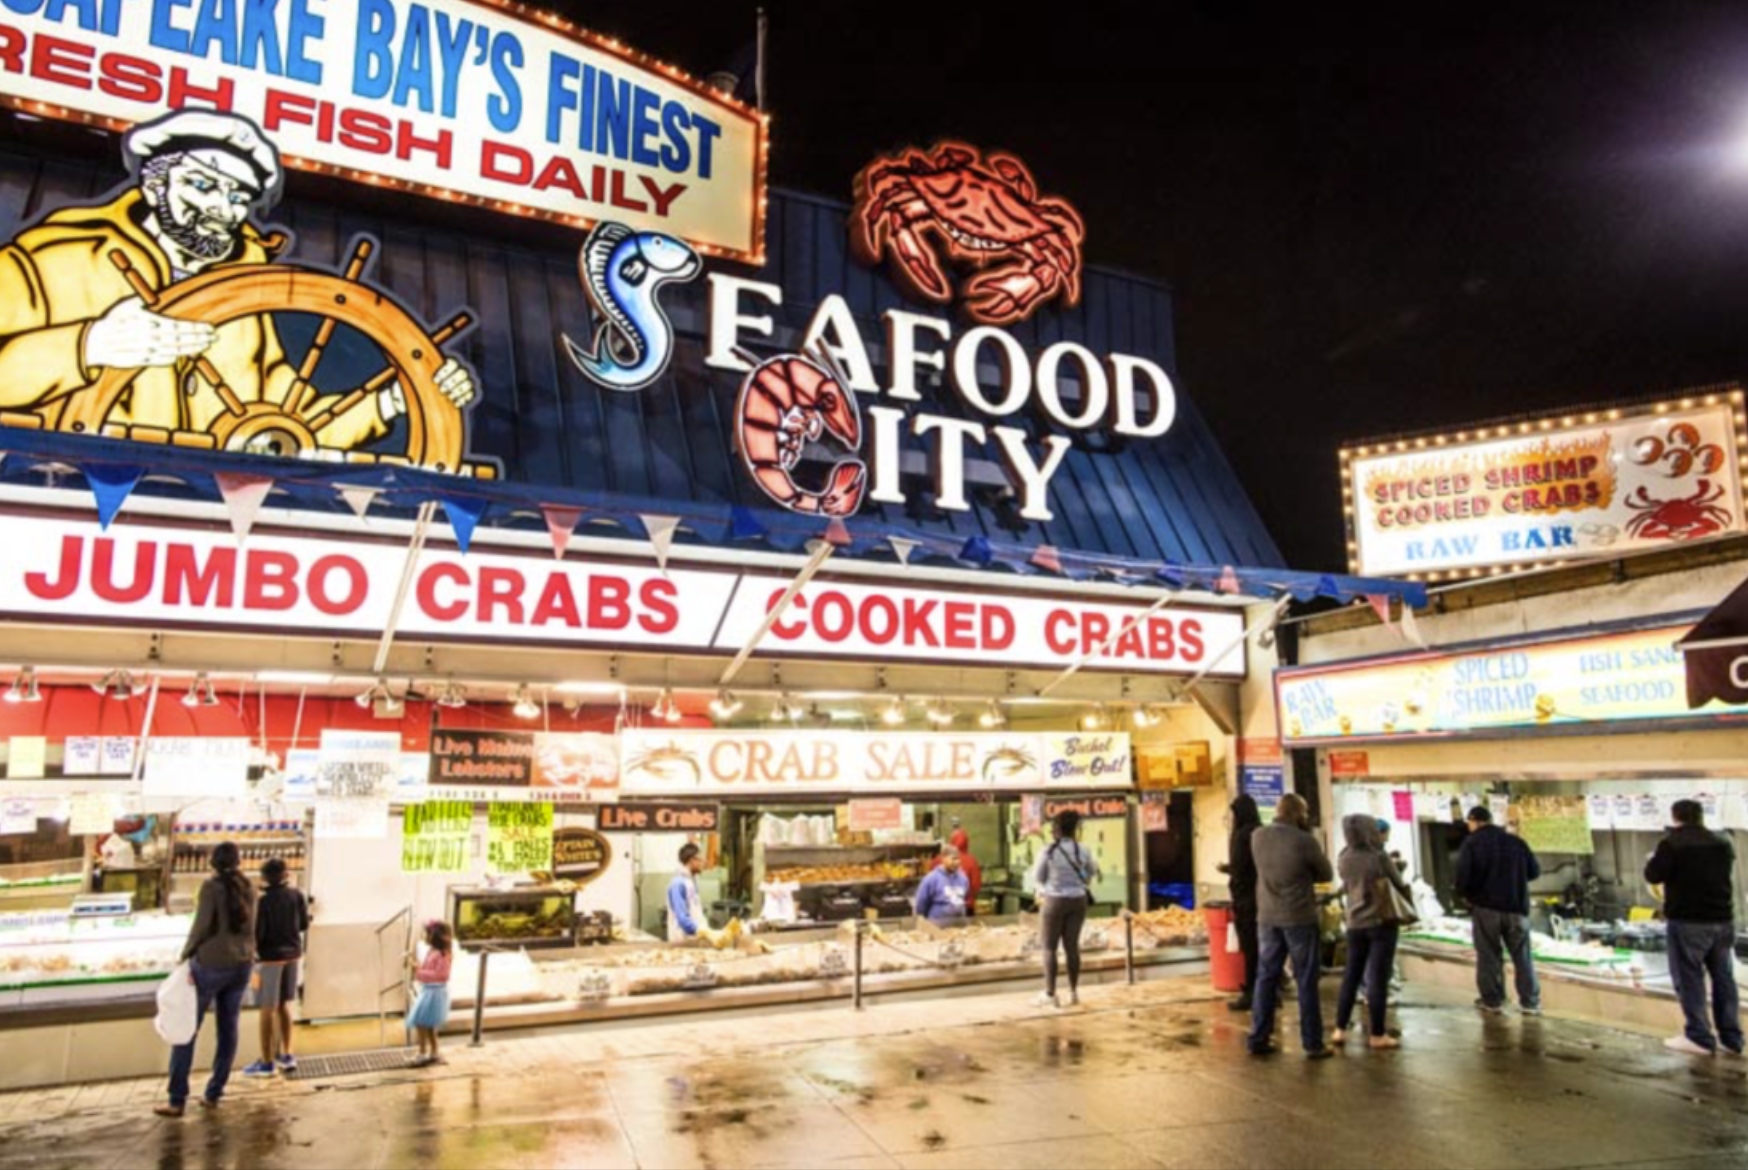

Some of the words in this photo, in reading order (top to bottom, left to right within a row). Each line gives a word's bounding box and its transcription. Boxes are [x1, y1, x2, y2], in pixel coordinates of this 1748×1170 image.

[0, 0, 325, 86] EAKE
[352, 0, 525, 134] BAY'S
[545, 50, 722, 180] FINEST
[263, 87, 453, 170] FISH
[480, 139, 689, 218] DAILY
[1374, 472, 1471, 503] SPICED
[1484, 454, 1599, 490] SHRIMP
[1376, 495, 1492, 528] COOKED
[1501, 480, 1601, 514] CRABS
[1406, 533, 1479, 560] RAW
[1500, 525, 1576, 552] BAR
[24, 535, 369, 616] JUMBO
[414, 561, 680, 634] CRABS
[765, 586, 1015, 651] COOKED
[1044, 608, 1206, 663] CRABS
[1453, 652, 1529, 686] SPICED
[1580, 652, 1622, 673] FISH
[1453, 682, 1537, 714] SHRIMP
[1579, 680, 1676, 706] SEAFOOD
[433, 736, 474, 756] Live
[707, 739, 839, 784] CRAB
[864, 740, 976, 783] SALE
[440, 756, 526, 779] Lobsters
[601, 806, 648, 828] Live
[655, 807, 716, 829] Crabs
